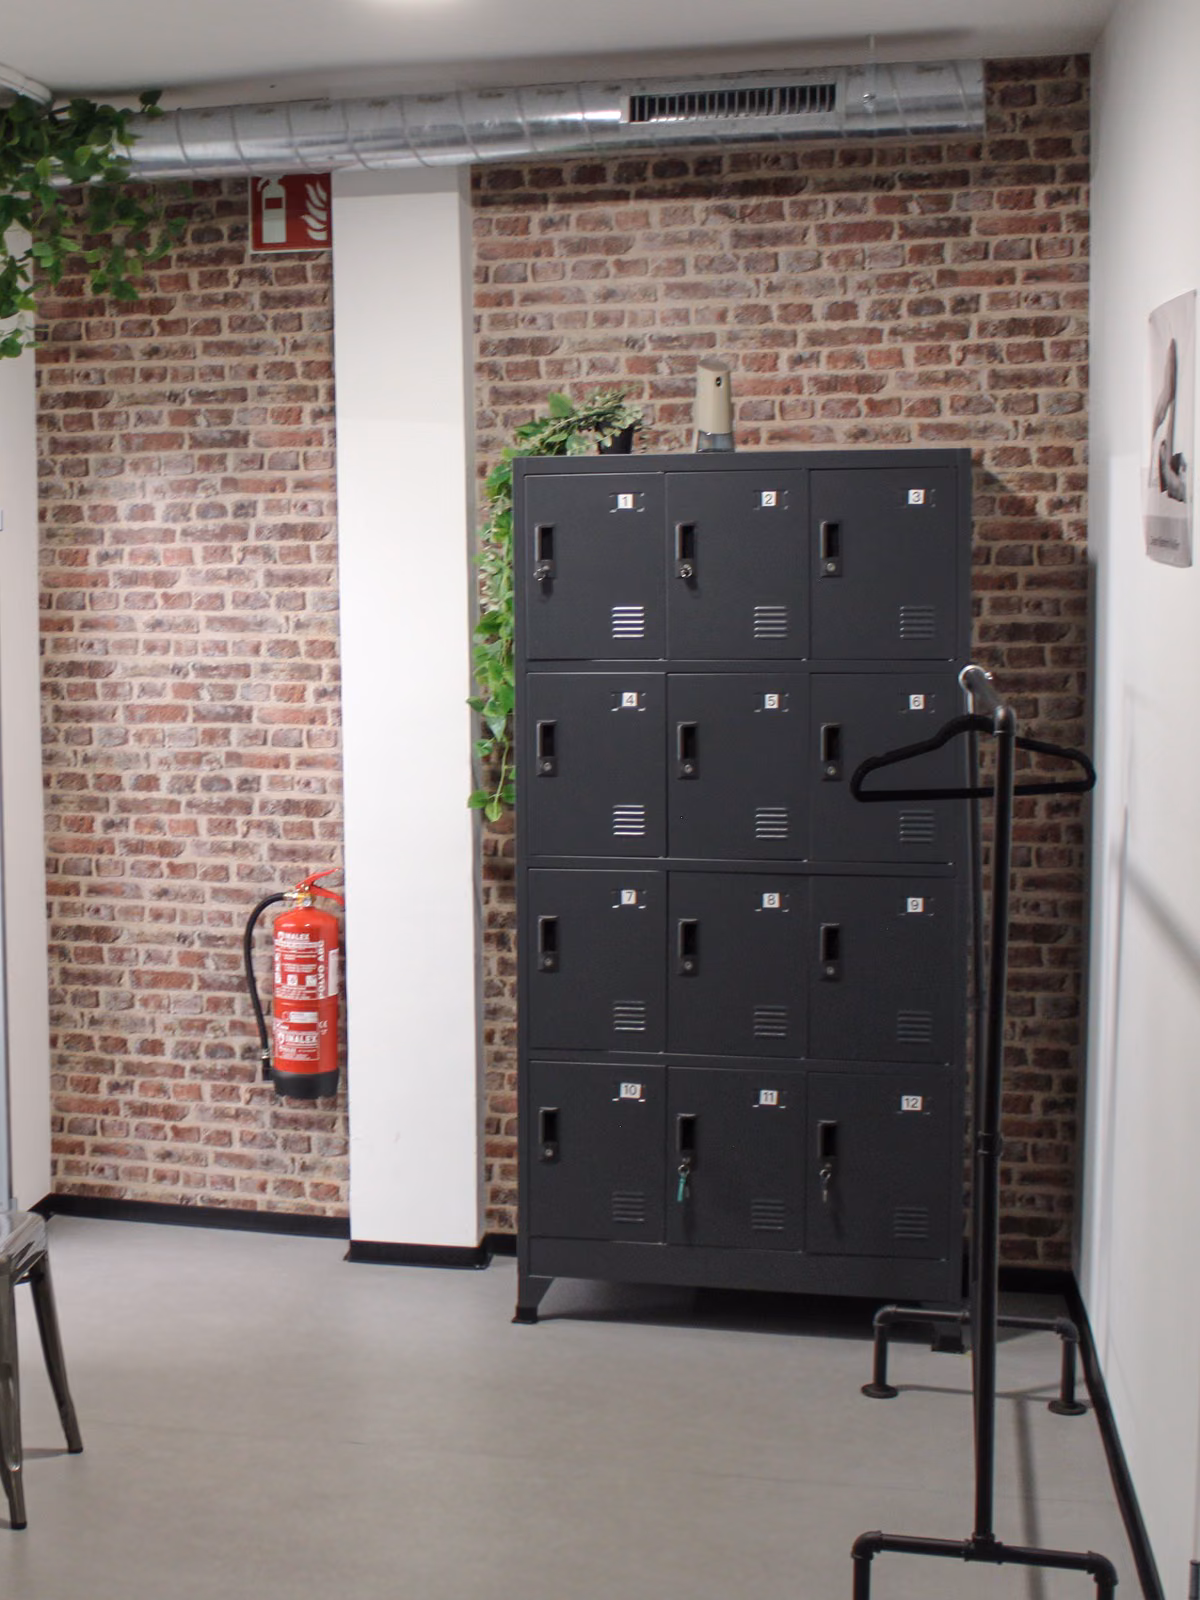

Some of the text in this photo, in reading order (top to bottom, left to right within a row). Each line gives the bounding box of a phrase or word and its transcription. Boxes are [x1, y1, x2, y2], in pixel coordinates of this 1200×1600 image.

[764, 494, 773, 505] 2
[912, 491, 921, 502] 3
[626, 694, 634, 705] 4
[767, 696, 775, 706] 5
[913, 696, 921, 707] 6
[626, 891, 634, 901] 7
[767, 895, 775, 905] 8
[911, 900, 919, 910] 9
[624, 1085, 637, 1095] 10
[763, 1092, 774, 1102] 11
[905, 1098, 919, 1108] 12
